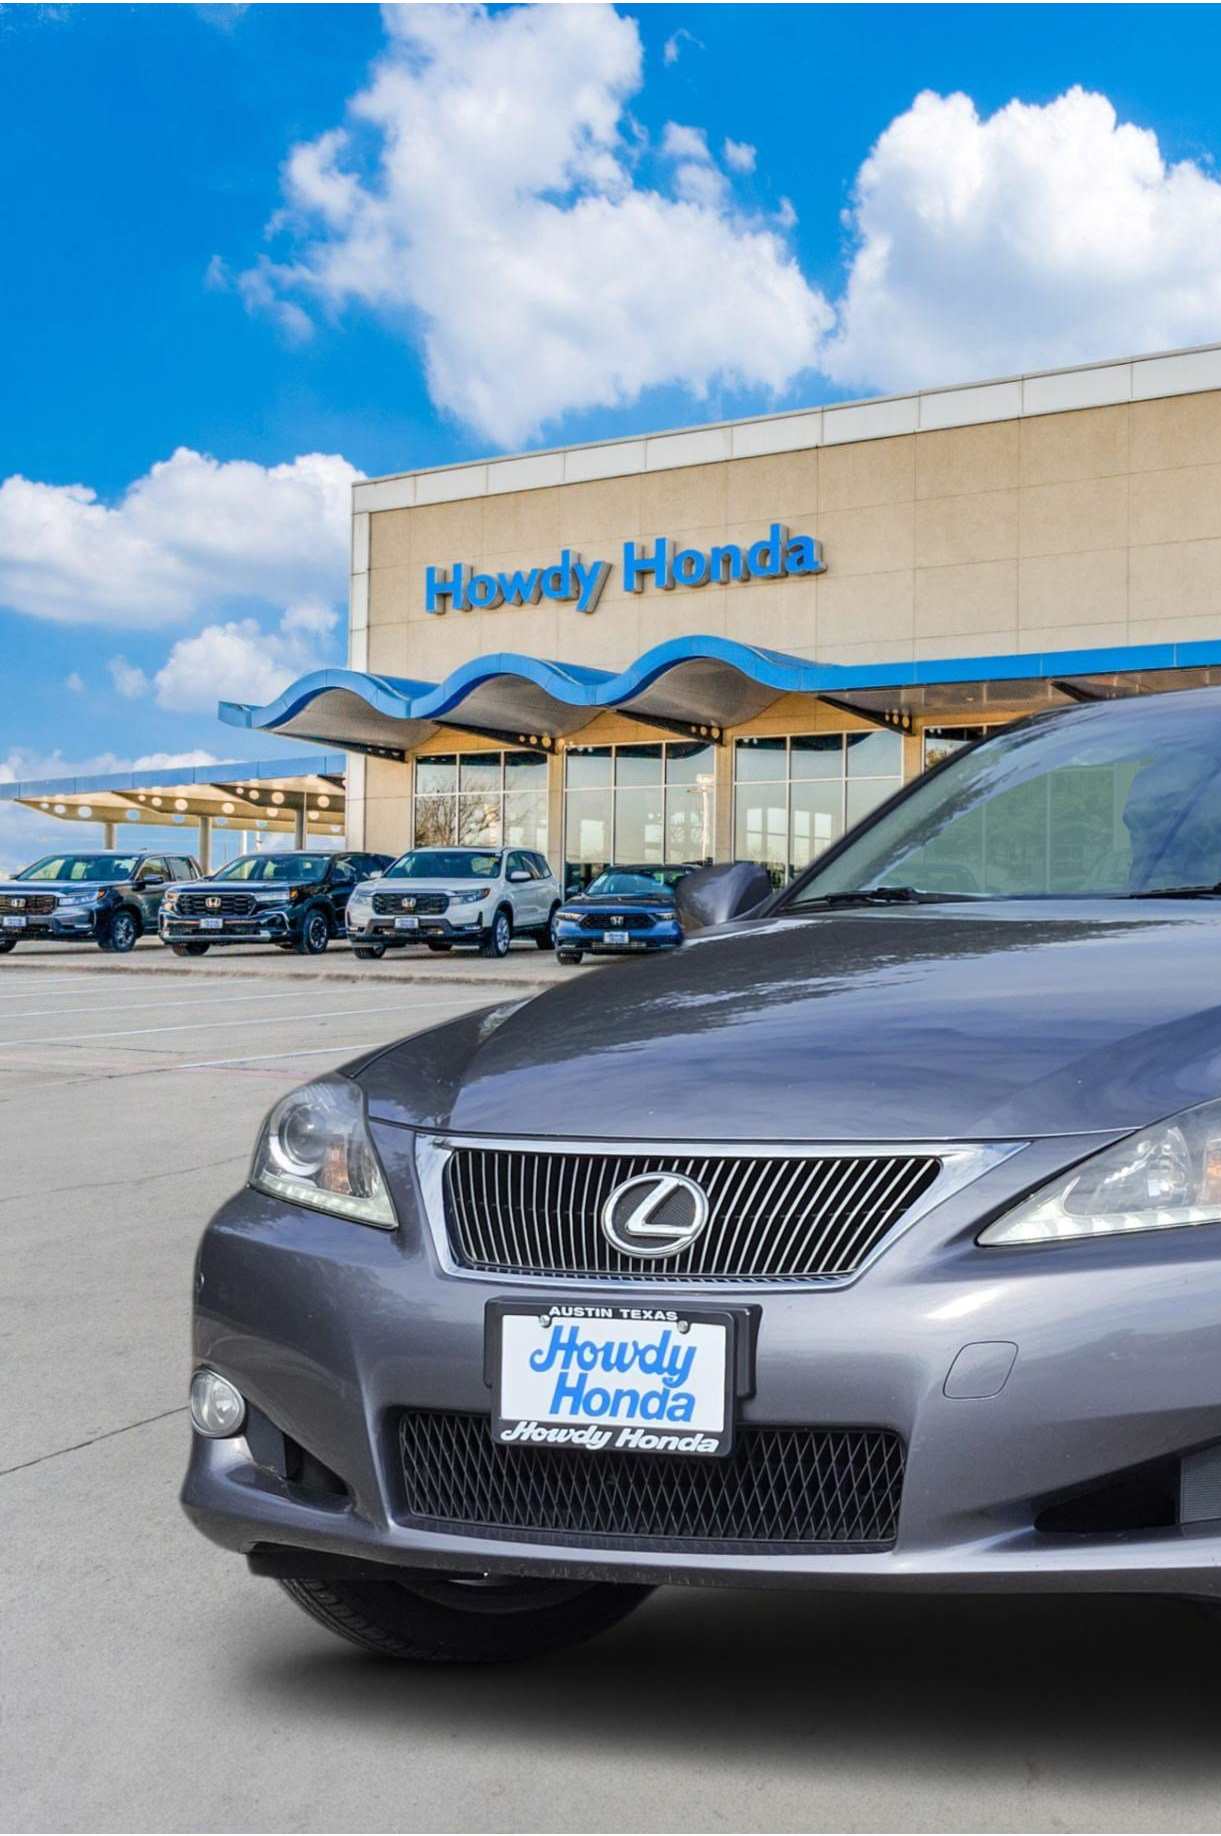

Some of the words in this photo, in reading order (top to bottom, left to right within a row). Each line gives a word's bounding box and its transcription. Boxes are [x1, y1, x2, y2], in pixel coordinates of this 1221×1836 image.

[425, 549, 612, 614] Howdy
[623, 523, 825, 594] Honda
[549, 1305, 613, 1319] AUSTIN
[620, 1307, 678, 1321] TEXAS
[529, 1325, 697, 1388] Howdy
[549, 1372, 696, 1423] Honda
[501, 1420, 612, 1450] Howdy
[615, 1428, 719, 1453] Honda
